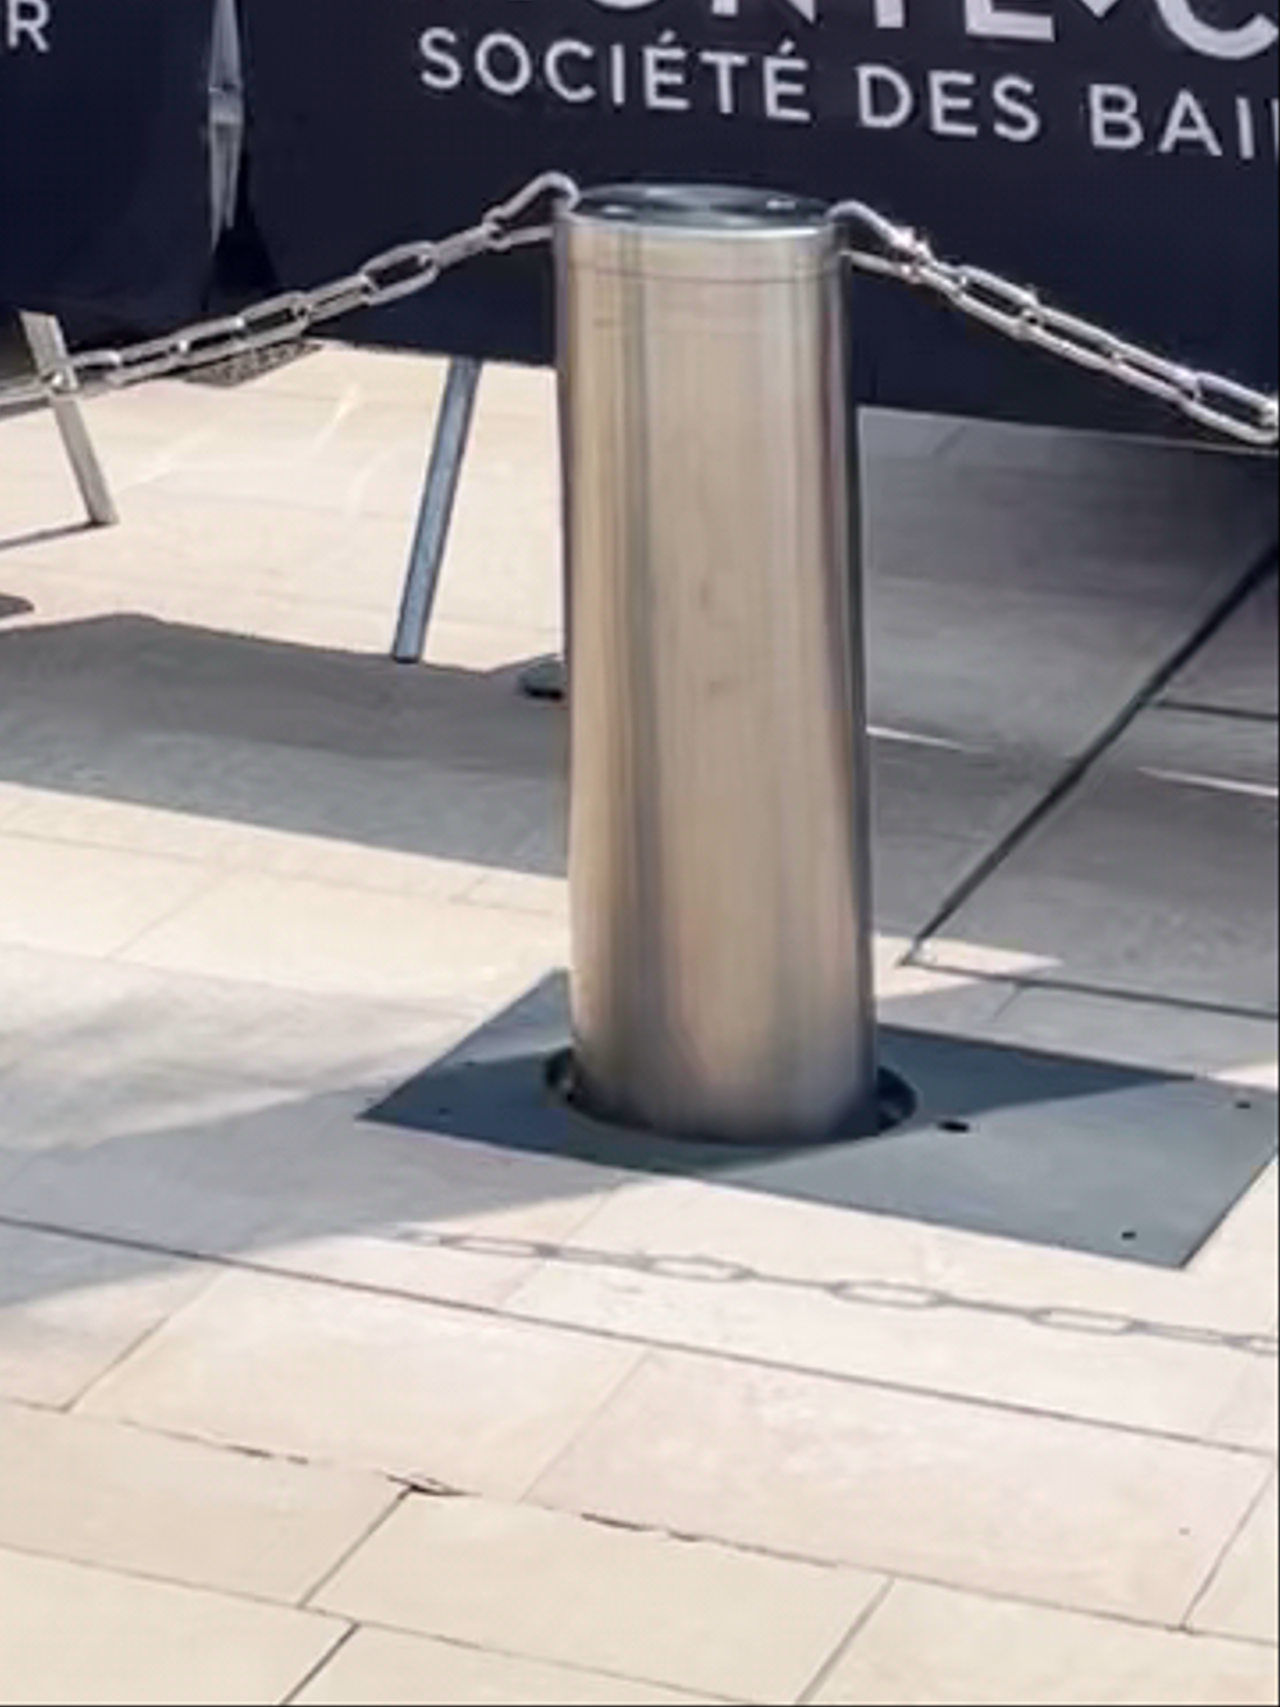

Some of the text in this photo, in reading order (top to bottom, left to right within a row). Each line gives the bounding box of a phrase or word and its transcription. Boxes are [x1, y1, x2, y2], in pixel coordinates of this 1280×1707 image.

[418, 27, 1279, 162] SOCIÉTÉ DES BAI
